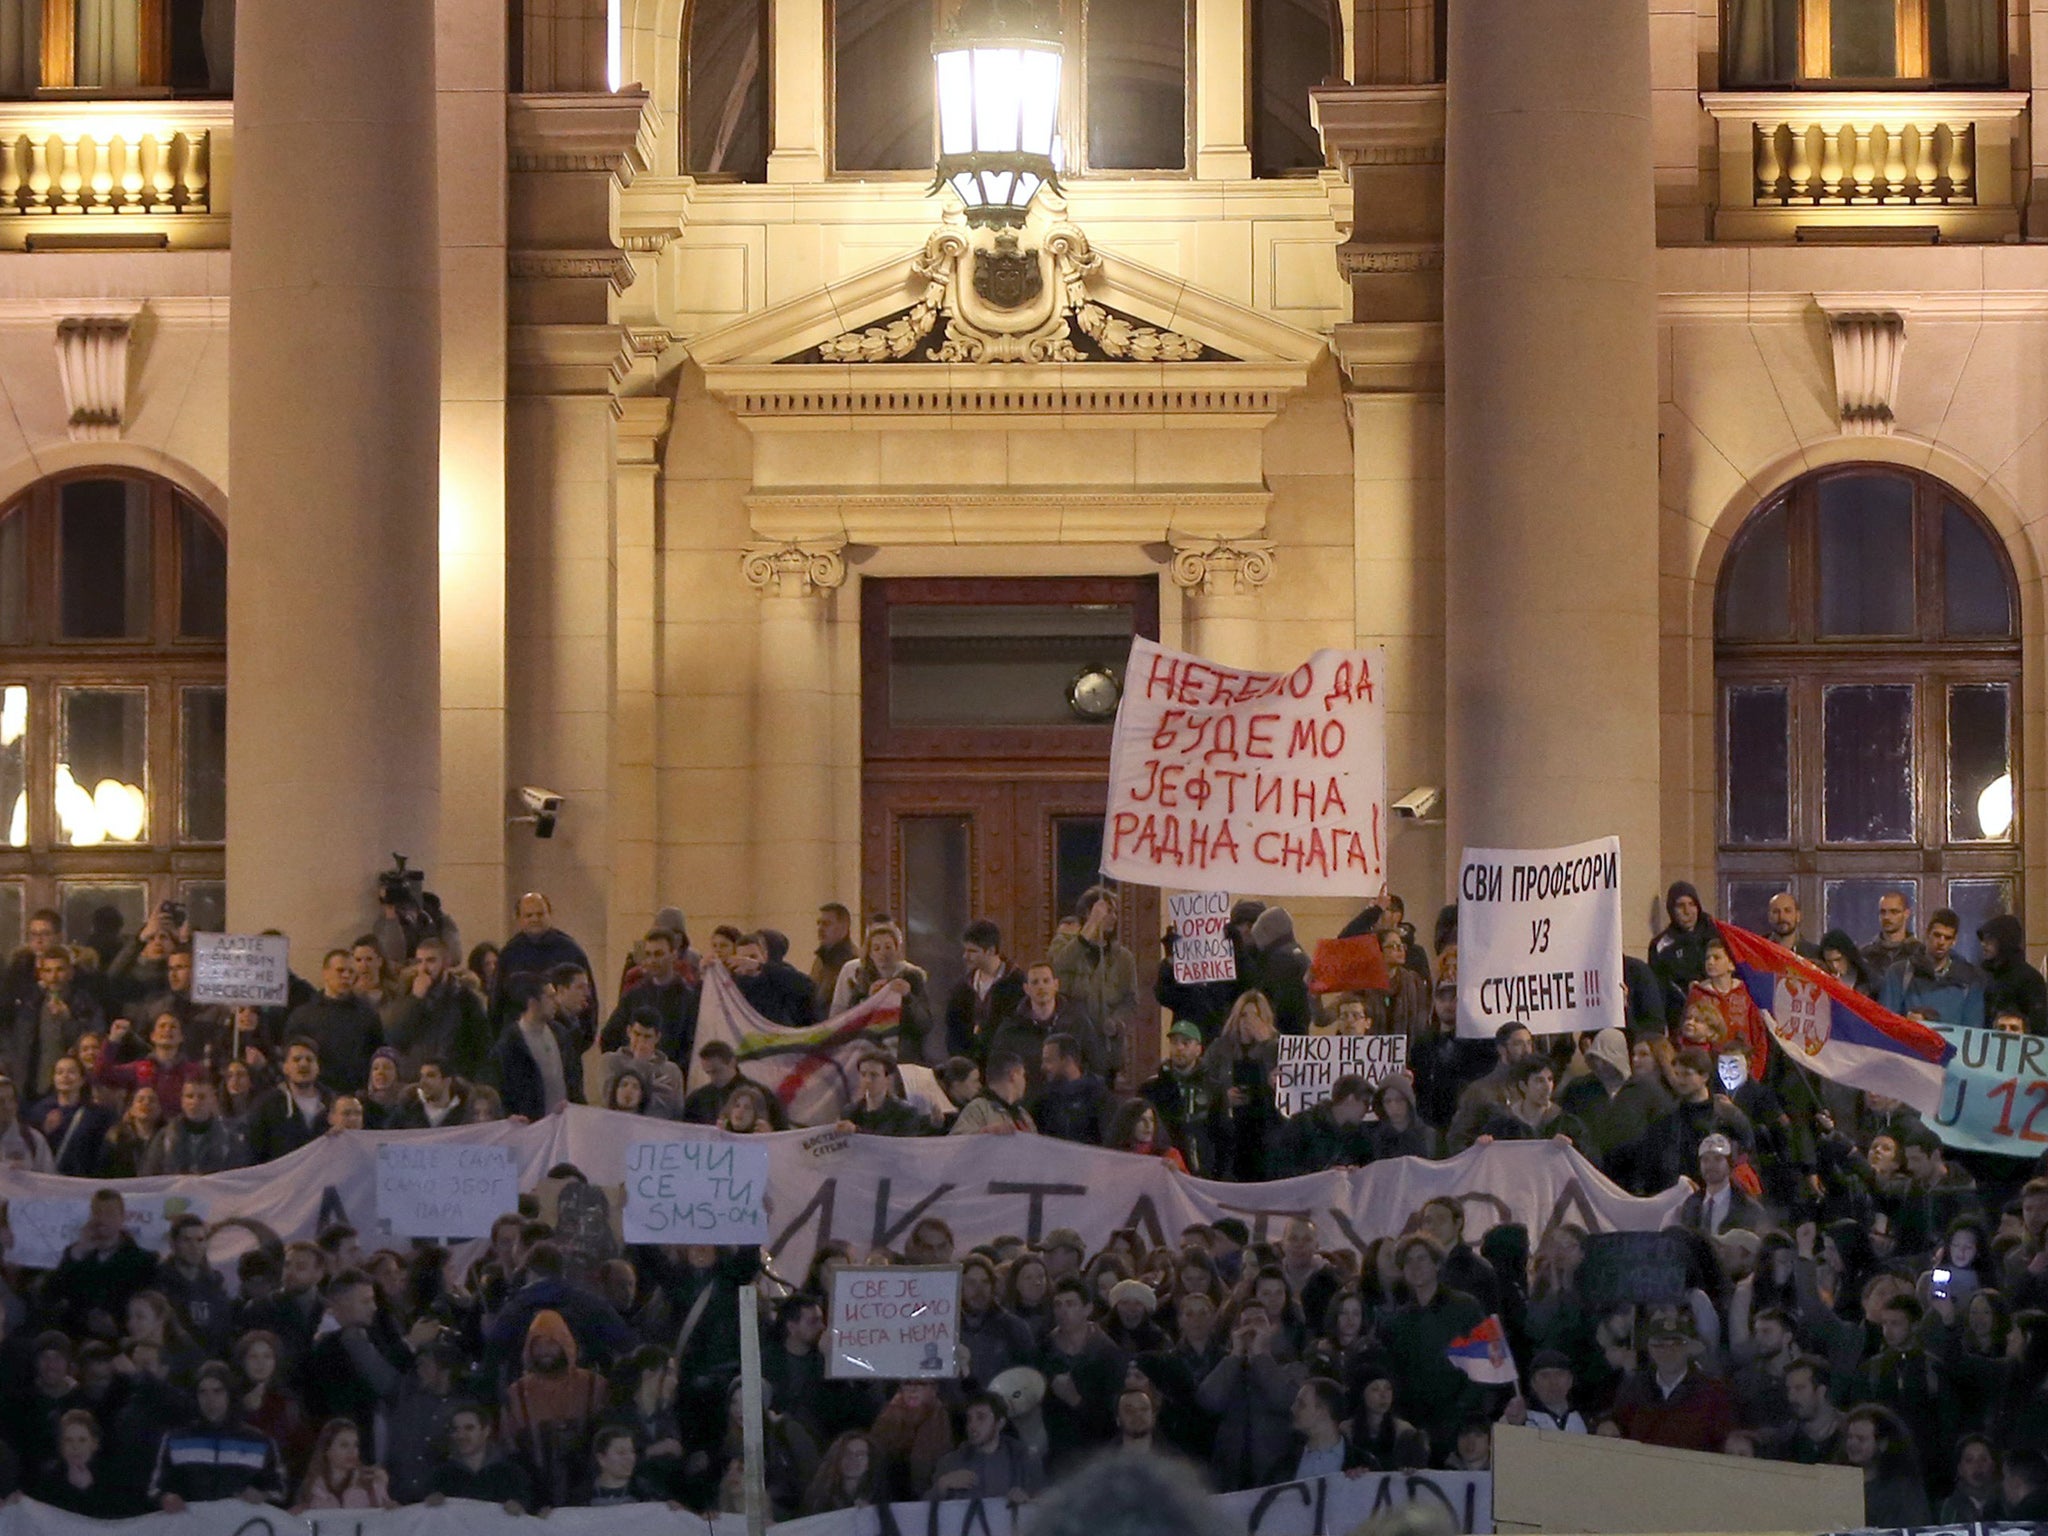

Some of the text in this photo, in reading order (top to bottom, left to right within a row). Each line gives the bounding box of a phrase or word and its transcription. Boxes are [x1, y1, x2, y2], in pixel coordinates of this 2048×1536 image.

[1324, 658, 1374, 711] ДА
[1152, 710, 1346, 764] БУДЕМО
[1131, 760, 1346, 822] ЈЕФТИНА
[1112, 803, 1381, 877] РАДНА СНАГА!
[1463, 852, 1617, 902] СВИ ПРОФЕСОРИ
[1529, 918, 1551, 954] УЗ
[1175, 959, 1234, 981] FABRIKE
[1480, 969, 1600, 1021] СТУДЕНТЕ !!!
[1280, 1037, 1331, 1061] НИКО
[1932, 1027, 2048, 1077] UTR
[1279, 1062, 1331, 1088] БИТИ
[629, 1142, 734, 1177] ЛЕЧИ
[638, 1174, 753, 1206] СЕ ТИ
[850, 1279, 921, 1299] СВЕ ЈЕ
[900, 1321, 949, 1344] НЕМА
